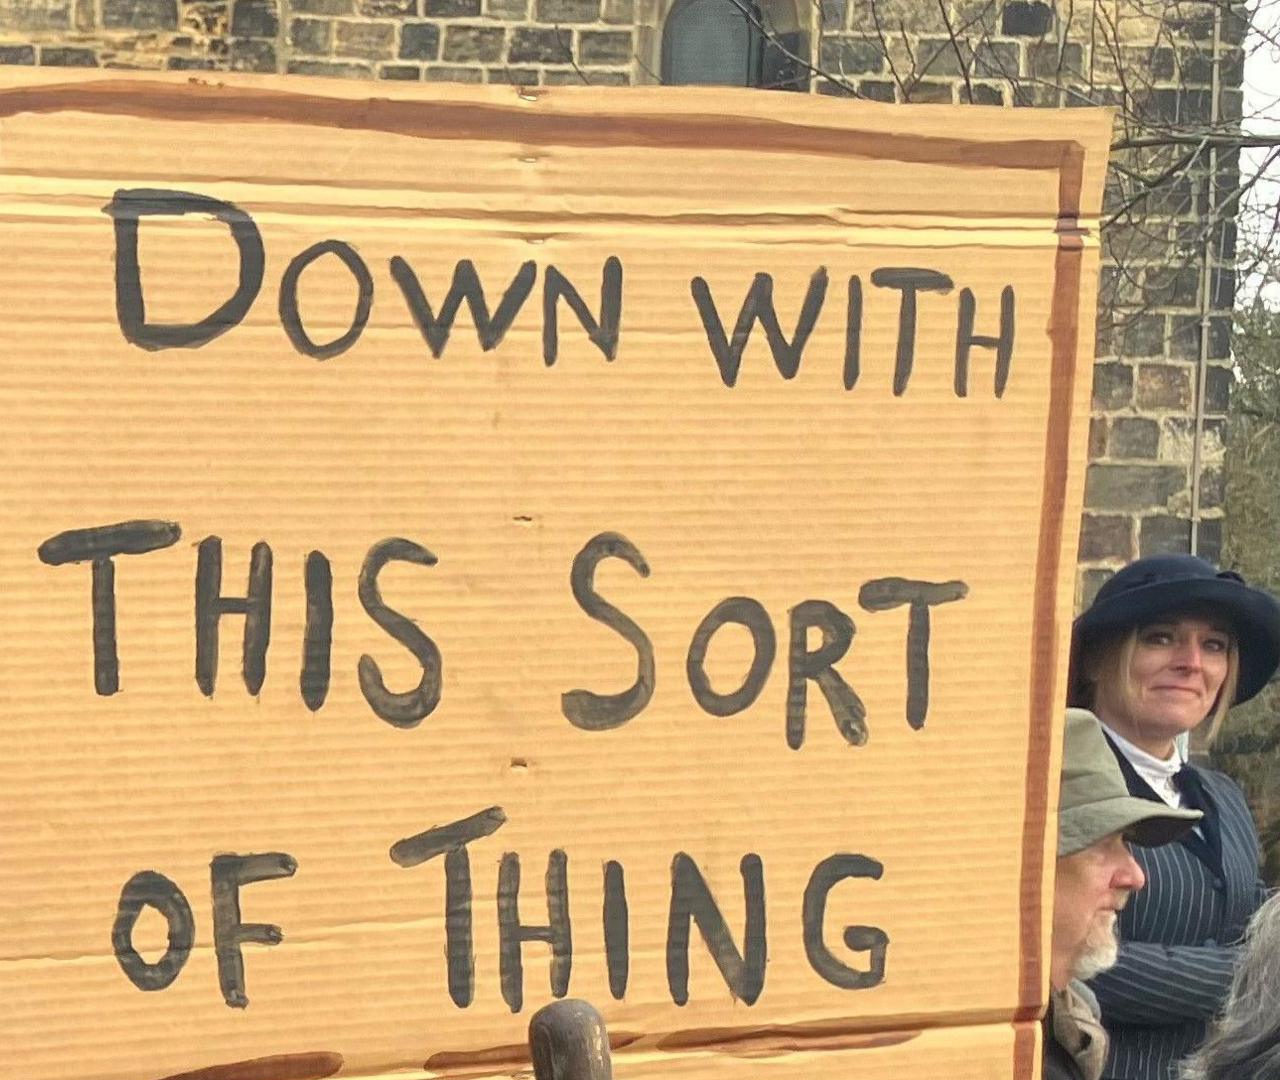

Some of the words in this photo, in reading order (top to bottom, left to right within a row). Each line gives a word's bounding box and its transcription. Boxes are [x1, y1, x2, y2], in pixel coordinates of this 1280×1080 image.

[105, 189, 622, 362] DOWN
[693, 269, 1013, 394] WITH
[38, 518, 440, 726] THIS
[565, 533, 967, 748] SORT
[113, 853, 298, 1006] OF
[390, 806, 888, 1010] THING
